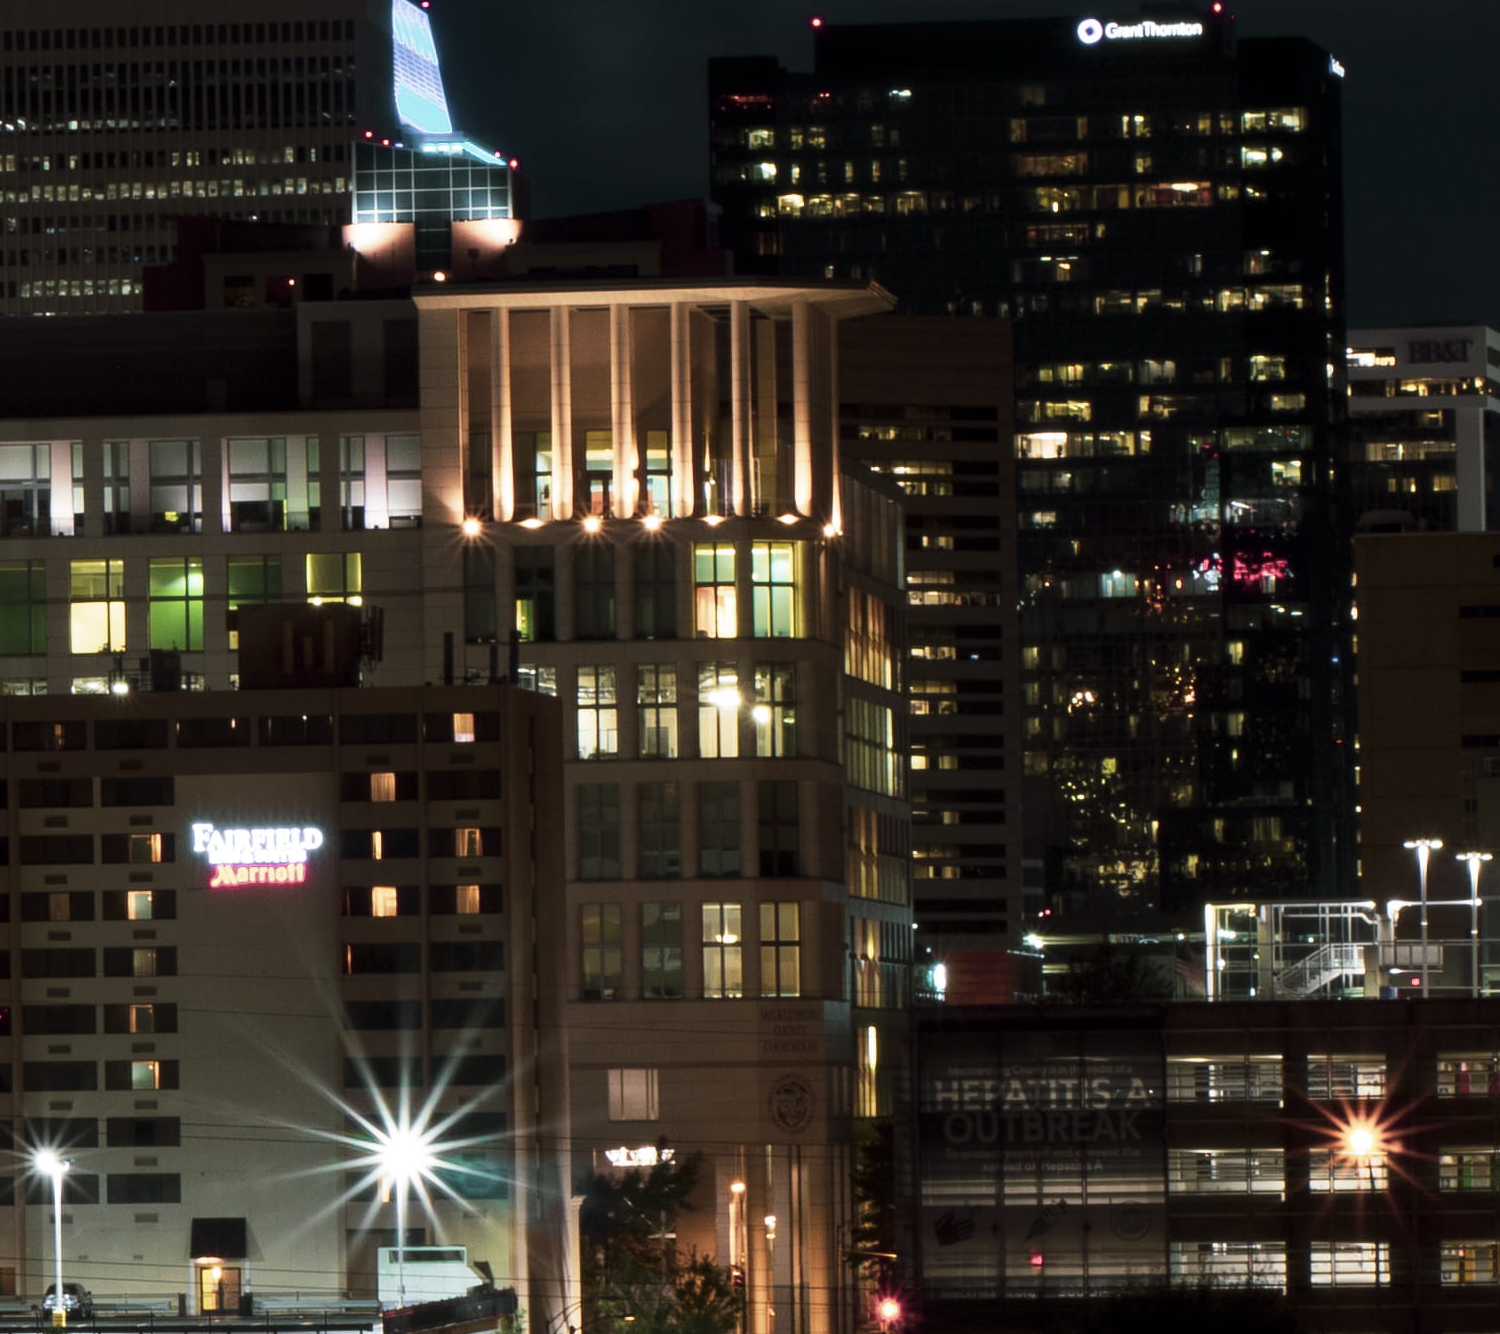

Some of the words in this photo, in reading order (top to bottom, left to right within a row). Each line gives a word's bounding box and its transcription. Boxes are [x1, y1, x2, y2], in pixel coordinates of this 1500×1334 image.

[192, 823, 323, 852] FAIRFIELD
[934, 1077, 1111, 1111] HEPATITIS
[1124, 1077, 1151, 1108] A
[942, 1111, 1142, 1143] OUTBREAK
